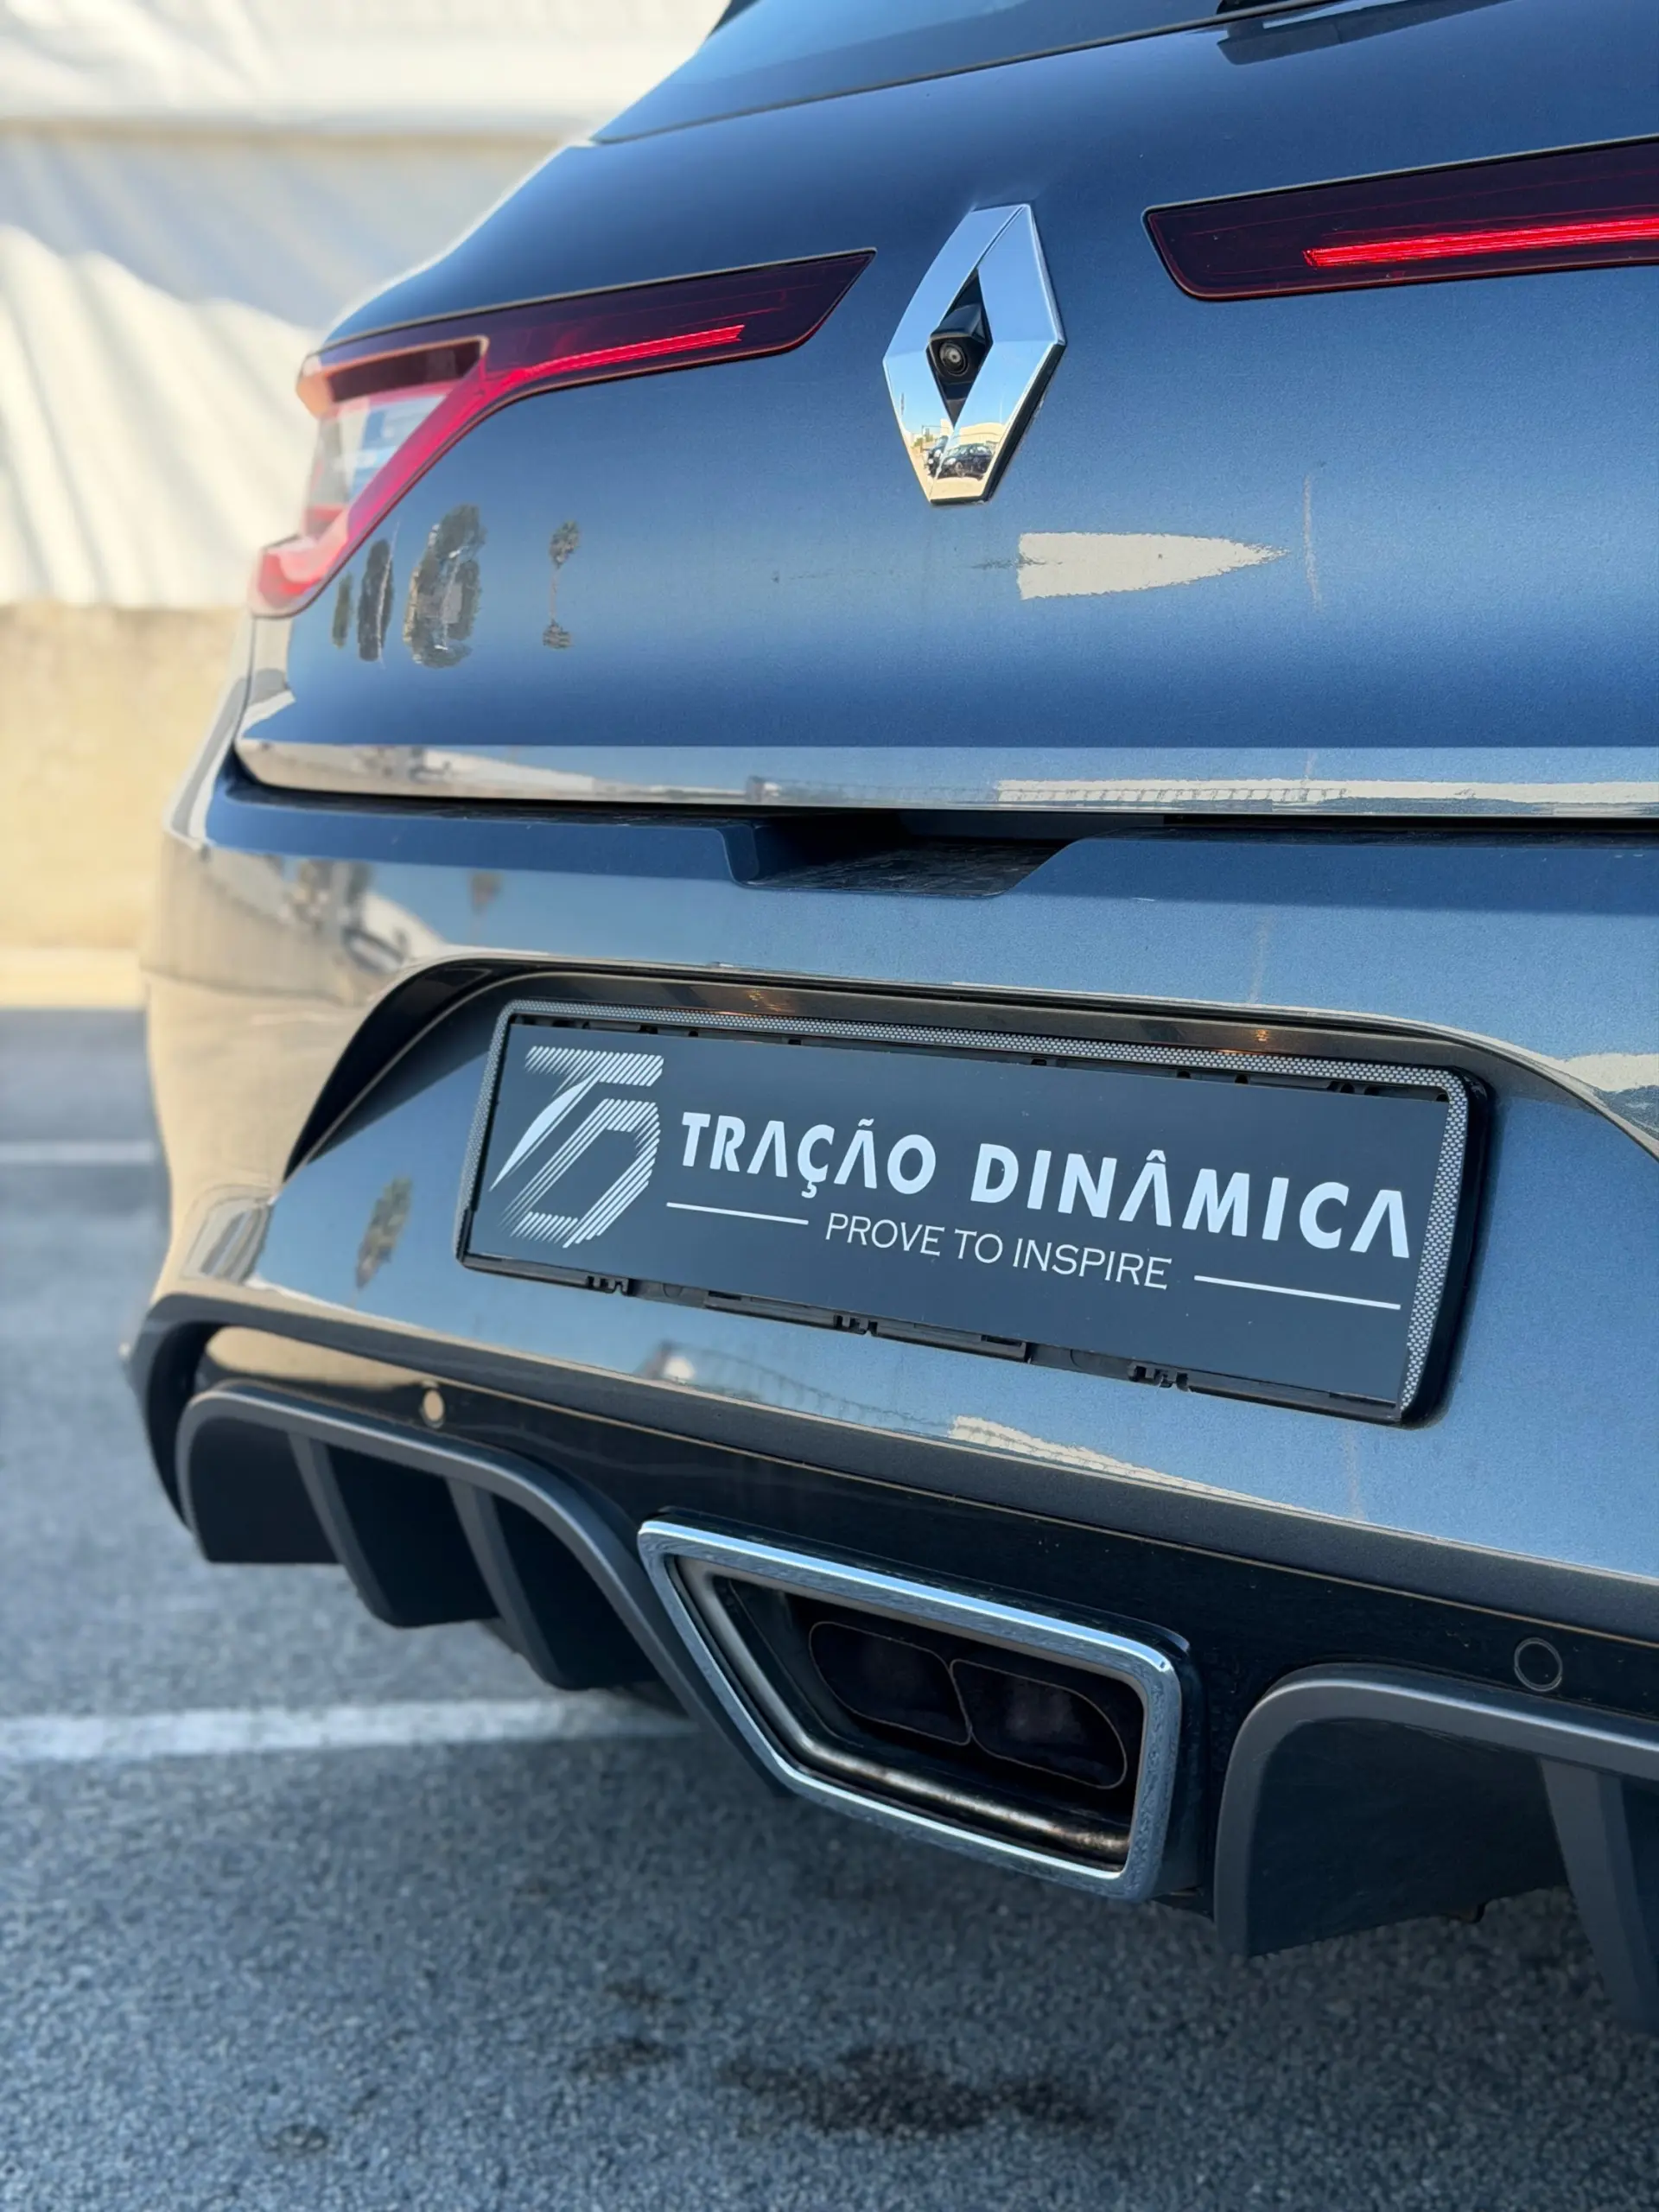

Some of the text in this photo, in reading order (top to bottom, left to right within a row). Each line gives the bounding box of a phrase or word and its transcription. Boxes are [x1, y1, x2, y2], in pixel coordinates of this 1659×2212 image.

[681, 1111, 1410, 1259] TRAÇÃO DINÂMICA
[825, 1212, 1173, 1290] PROVE TO INSPIRE
